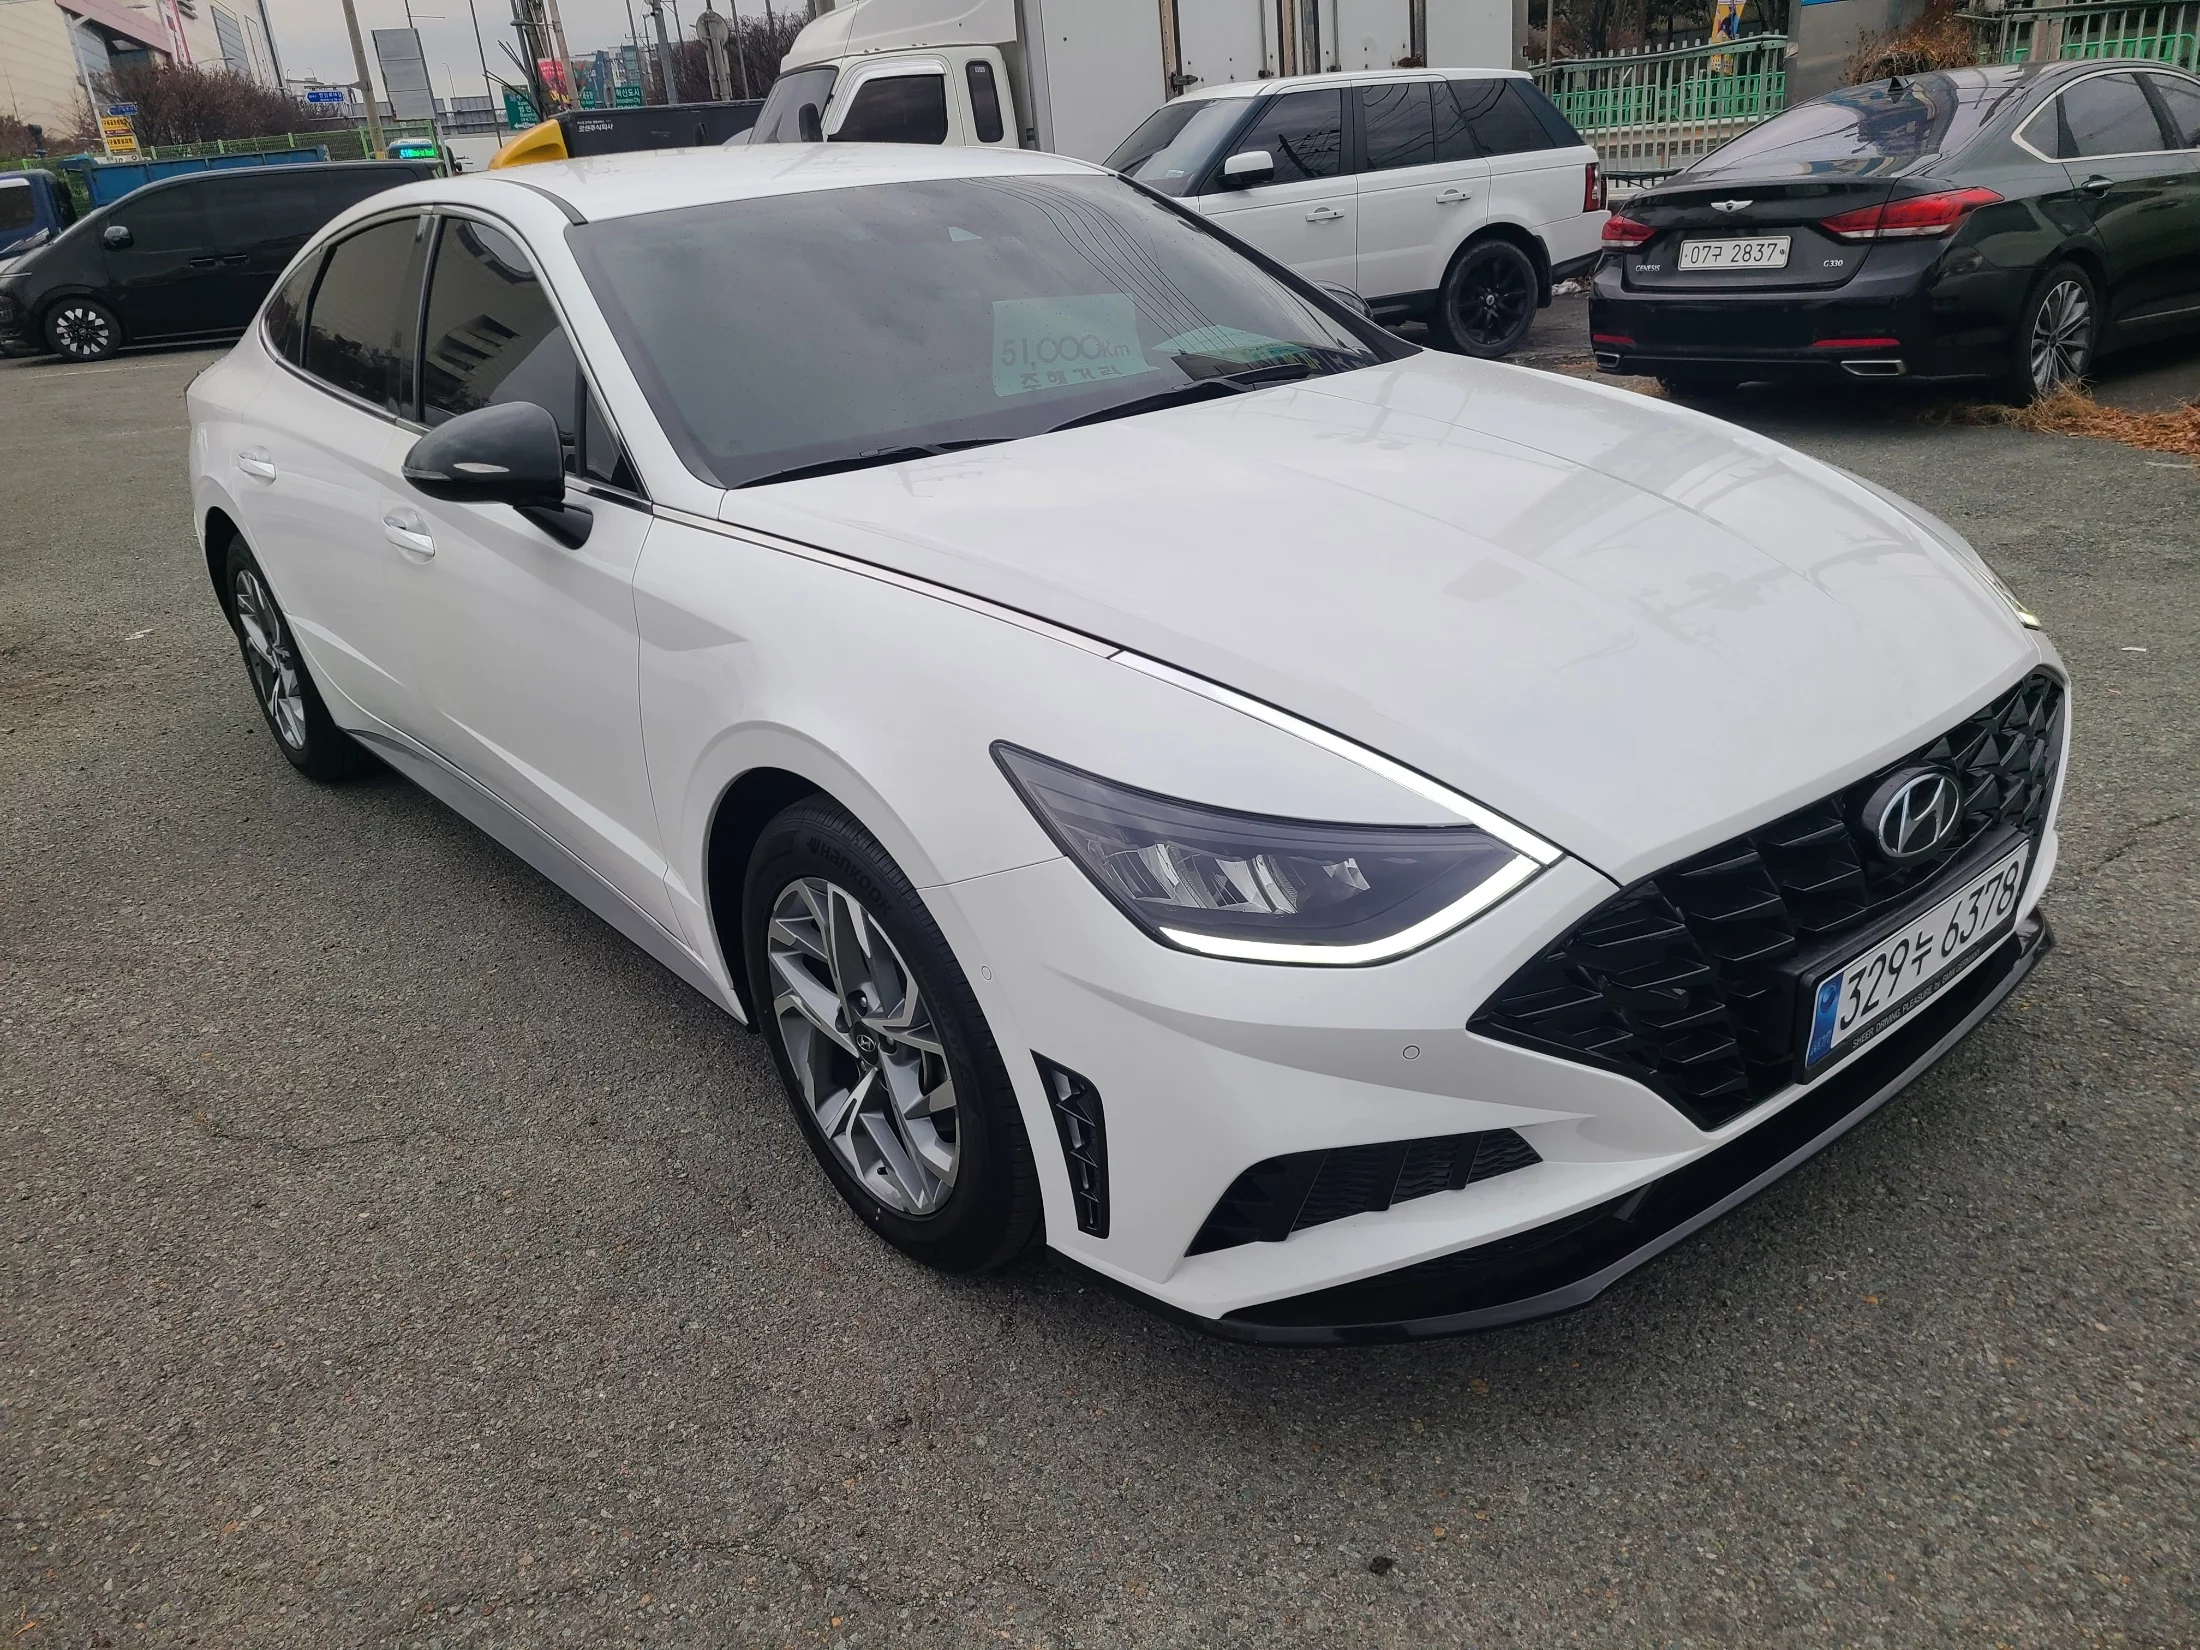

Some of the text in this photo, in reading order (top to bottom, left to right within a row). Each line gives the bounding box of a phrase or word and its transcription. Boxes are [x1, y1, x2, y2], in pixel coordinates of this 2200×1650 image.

[1690, 243, 1778, 264] 07구 2837
[1823, 259, 1844, 268] G330
[1635, 264, 1661, 272] GENESIS
[1840, 860, 2019, 1030] 329누 6378
[1852, 1027, 1875, 1049] SHEER
[1875, 1008, 1901, 1034] DRIVING
[1902, 985, 1933, 1013] PLEASURE
